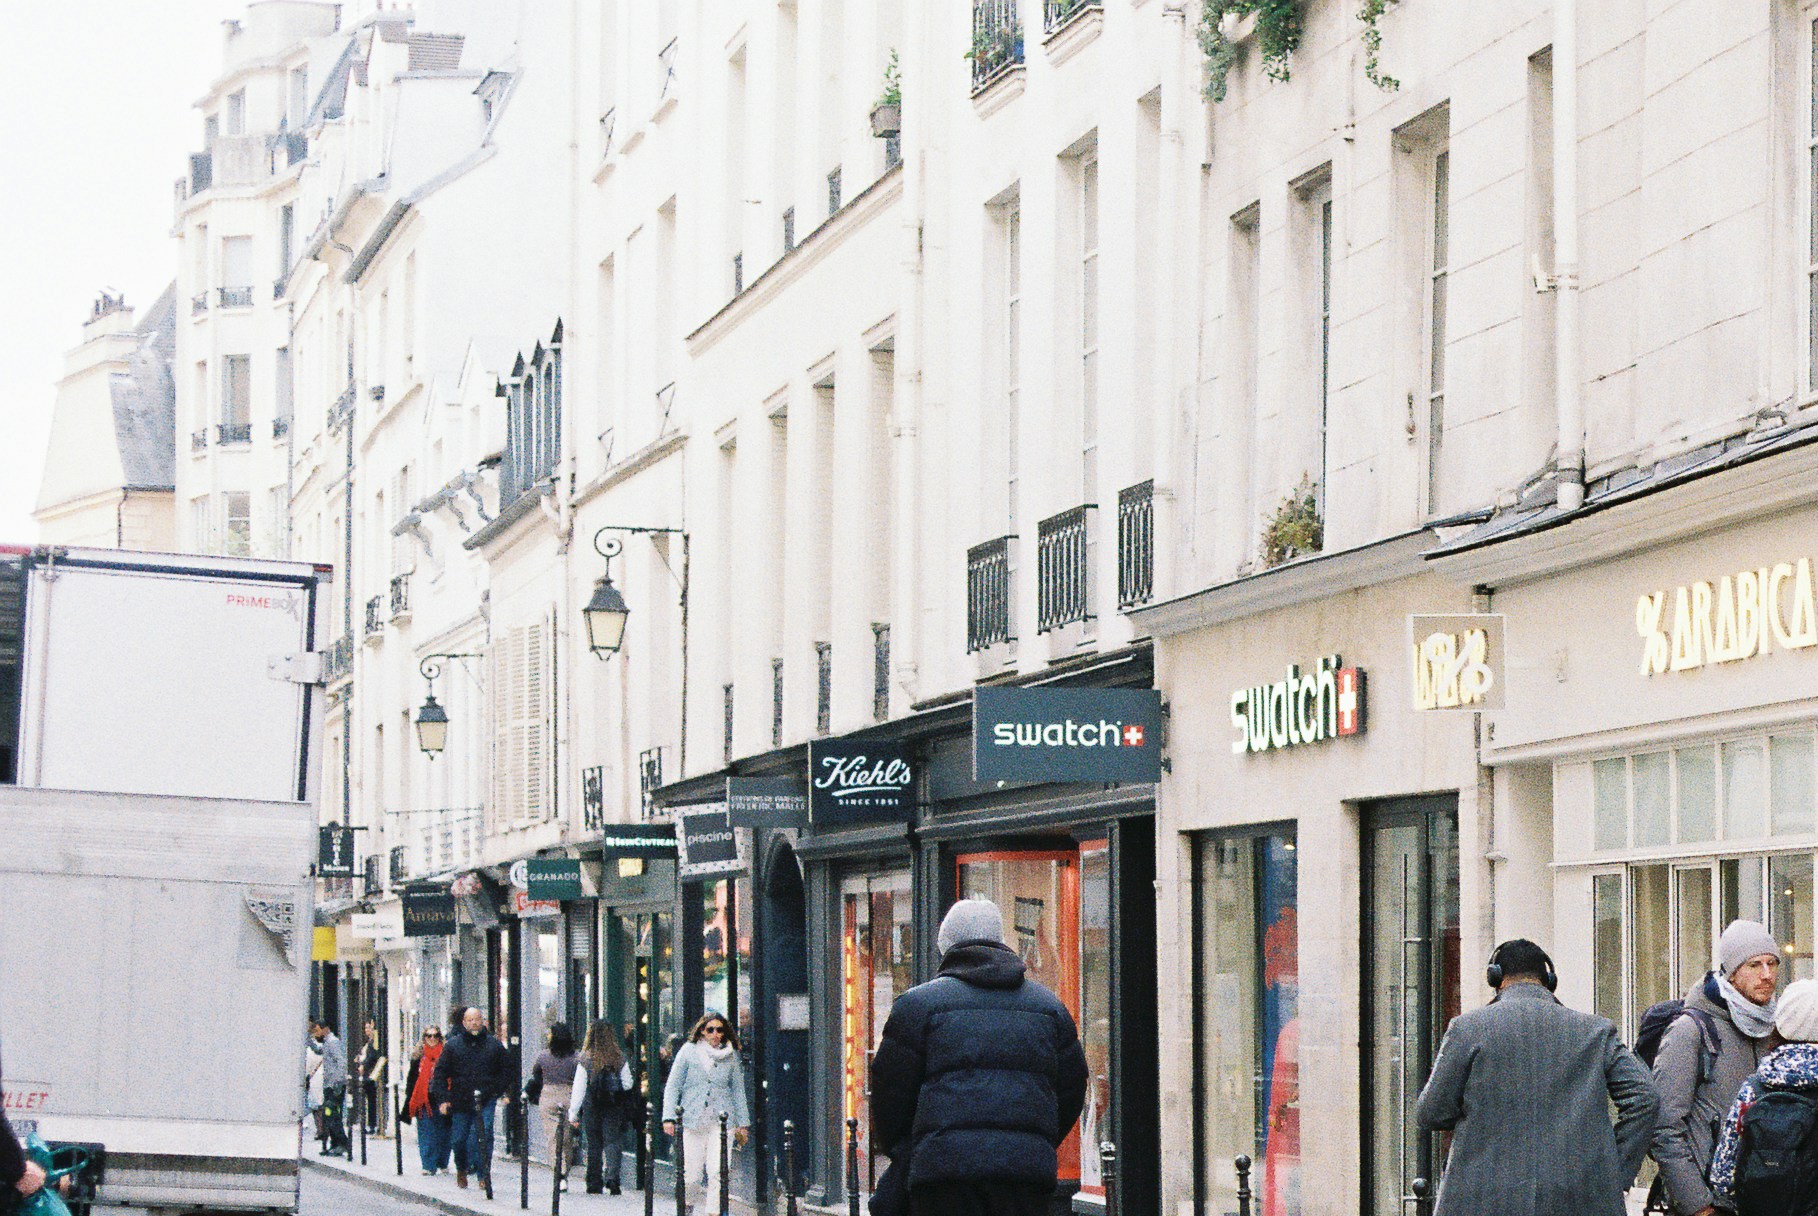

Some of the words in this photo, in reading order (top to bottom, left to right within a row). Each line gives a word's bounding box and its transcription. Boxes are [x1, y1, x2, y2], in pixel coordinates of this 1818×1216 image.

[1671, 557, 1818, 672] ARABICA
[1231, 656, 1338, 754] swatch
[993, 719, 1122, 747] swatch
[814, 755, 911, 789] Kiehl's
[838, 798, 870, 806] SINCE
[529, 872, 579, 882] GRANADO
[2, 1091, 49, 1109] LLET
